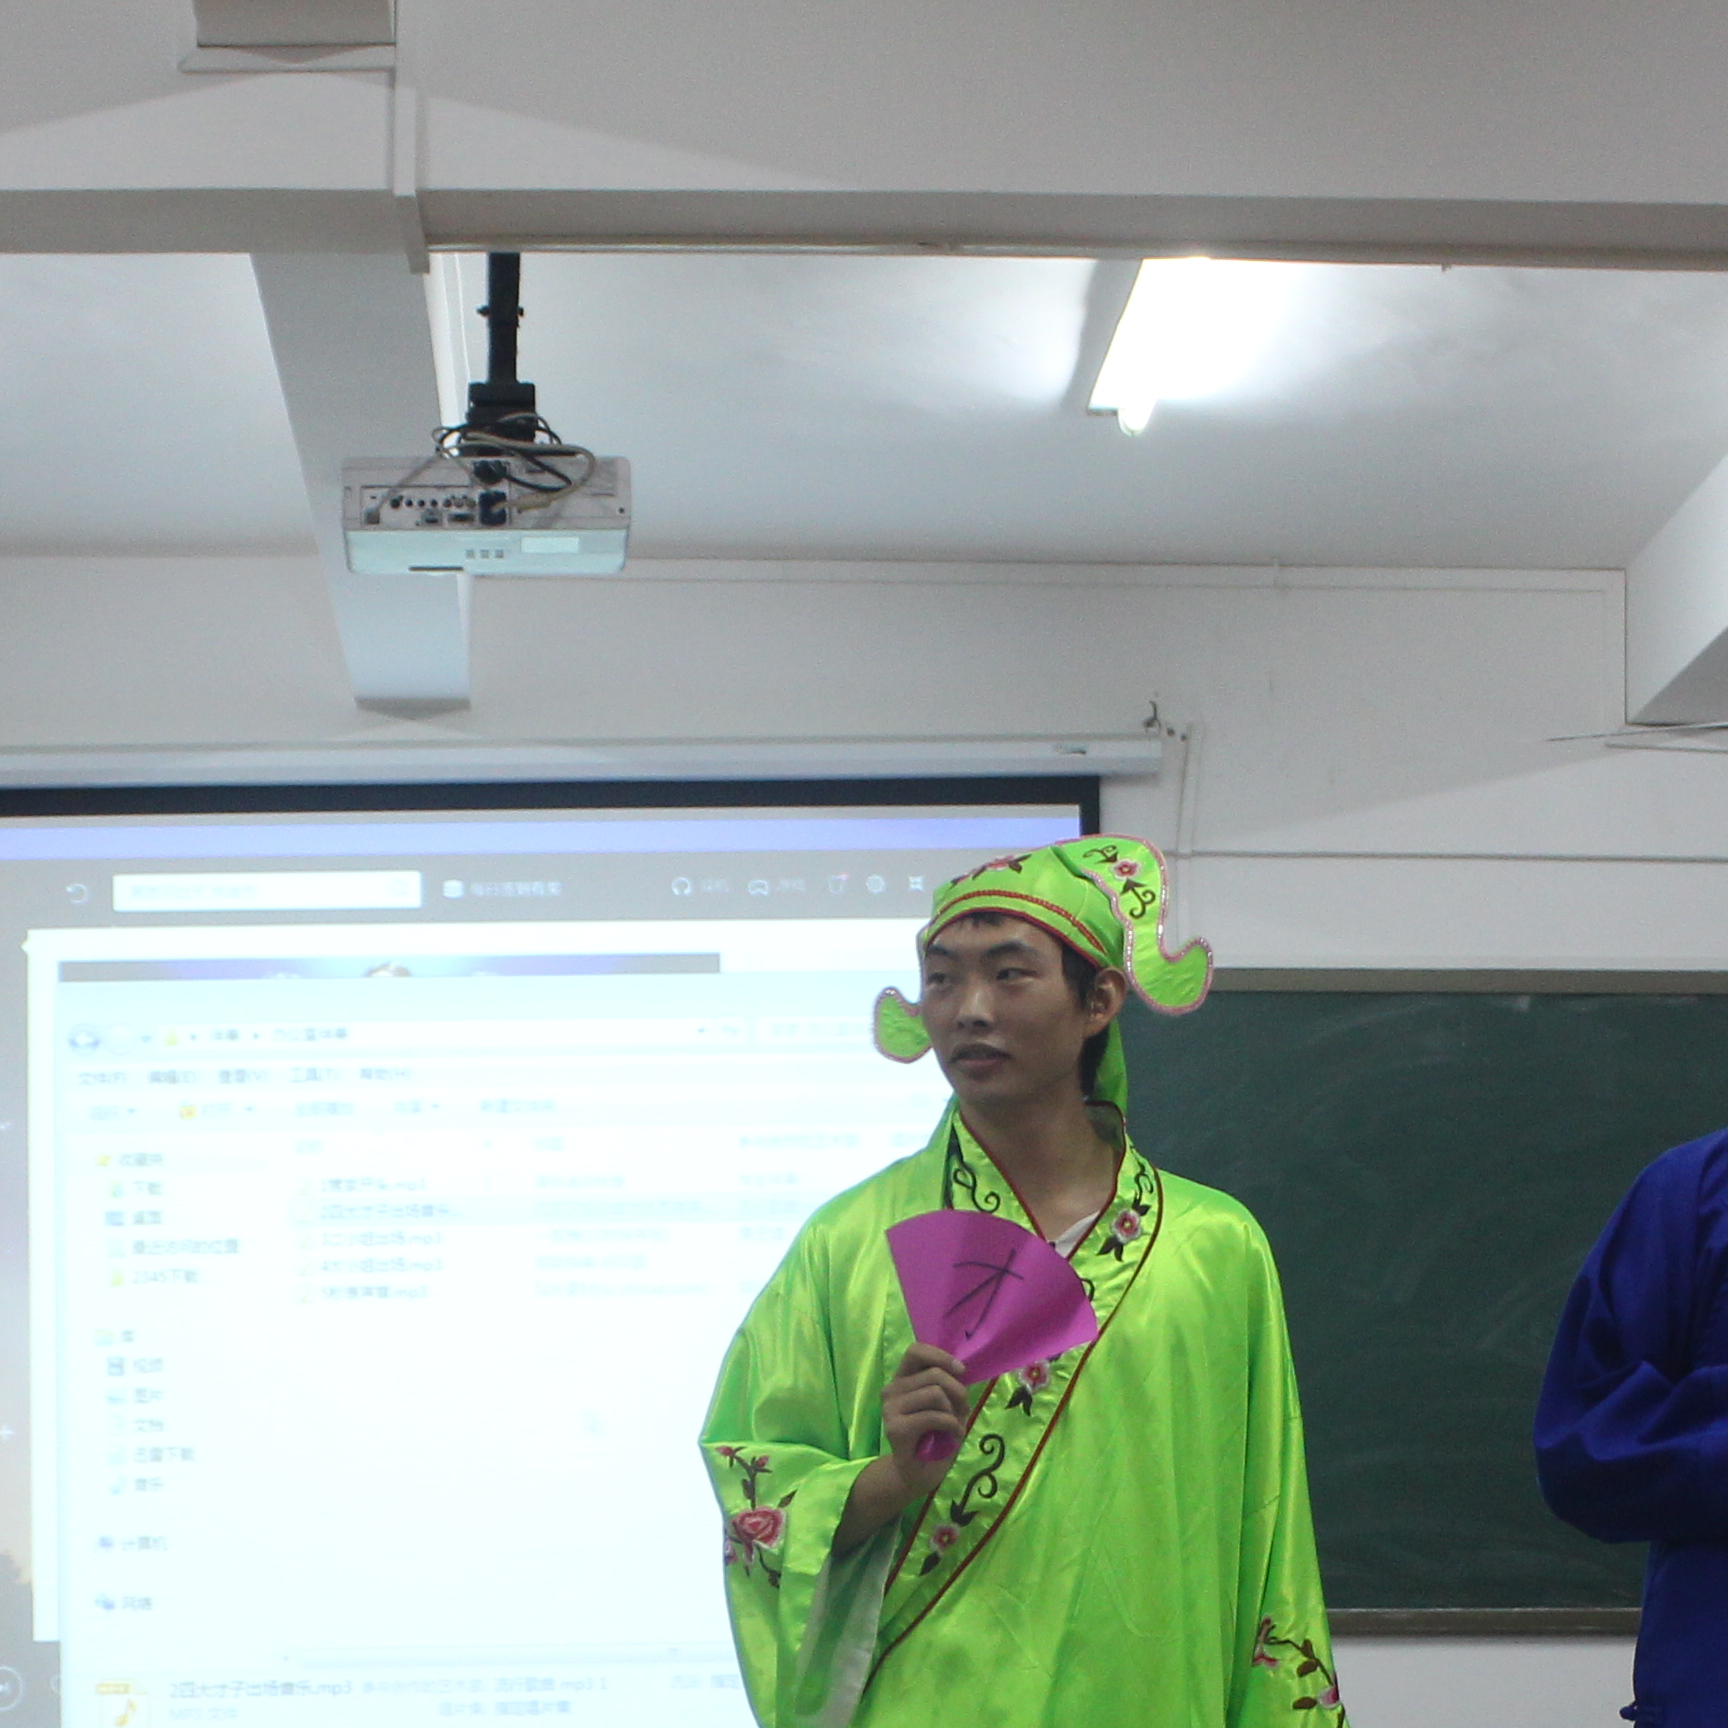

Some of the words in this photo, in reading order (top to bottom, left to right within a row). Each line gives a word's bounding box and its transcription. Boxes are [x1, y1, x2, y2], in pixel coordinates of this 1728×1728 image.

[77, 1070, 128, 1087] 文件(F)
[147, 1068, 198, 1086] 编辑(E)
[218, 1067, 270, 1085] 查看(V)
[288, 1066, 340, 1084] 工具(T)
[130, 1267, 201, 1285] 2345下载
